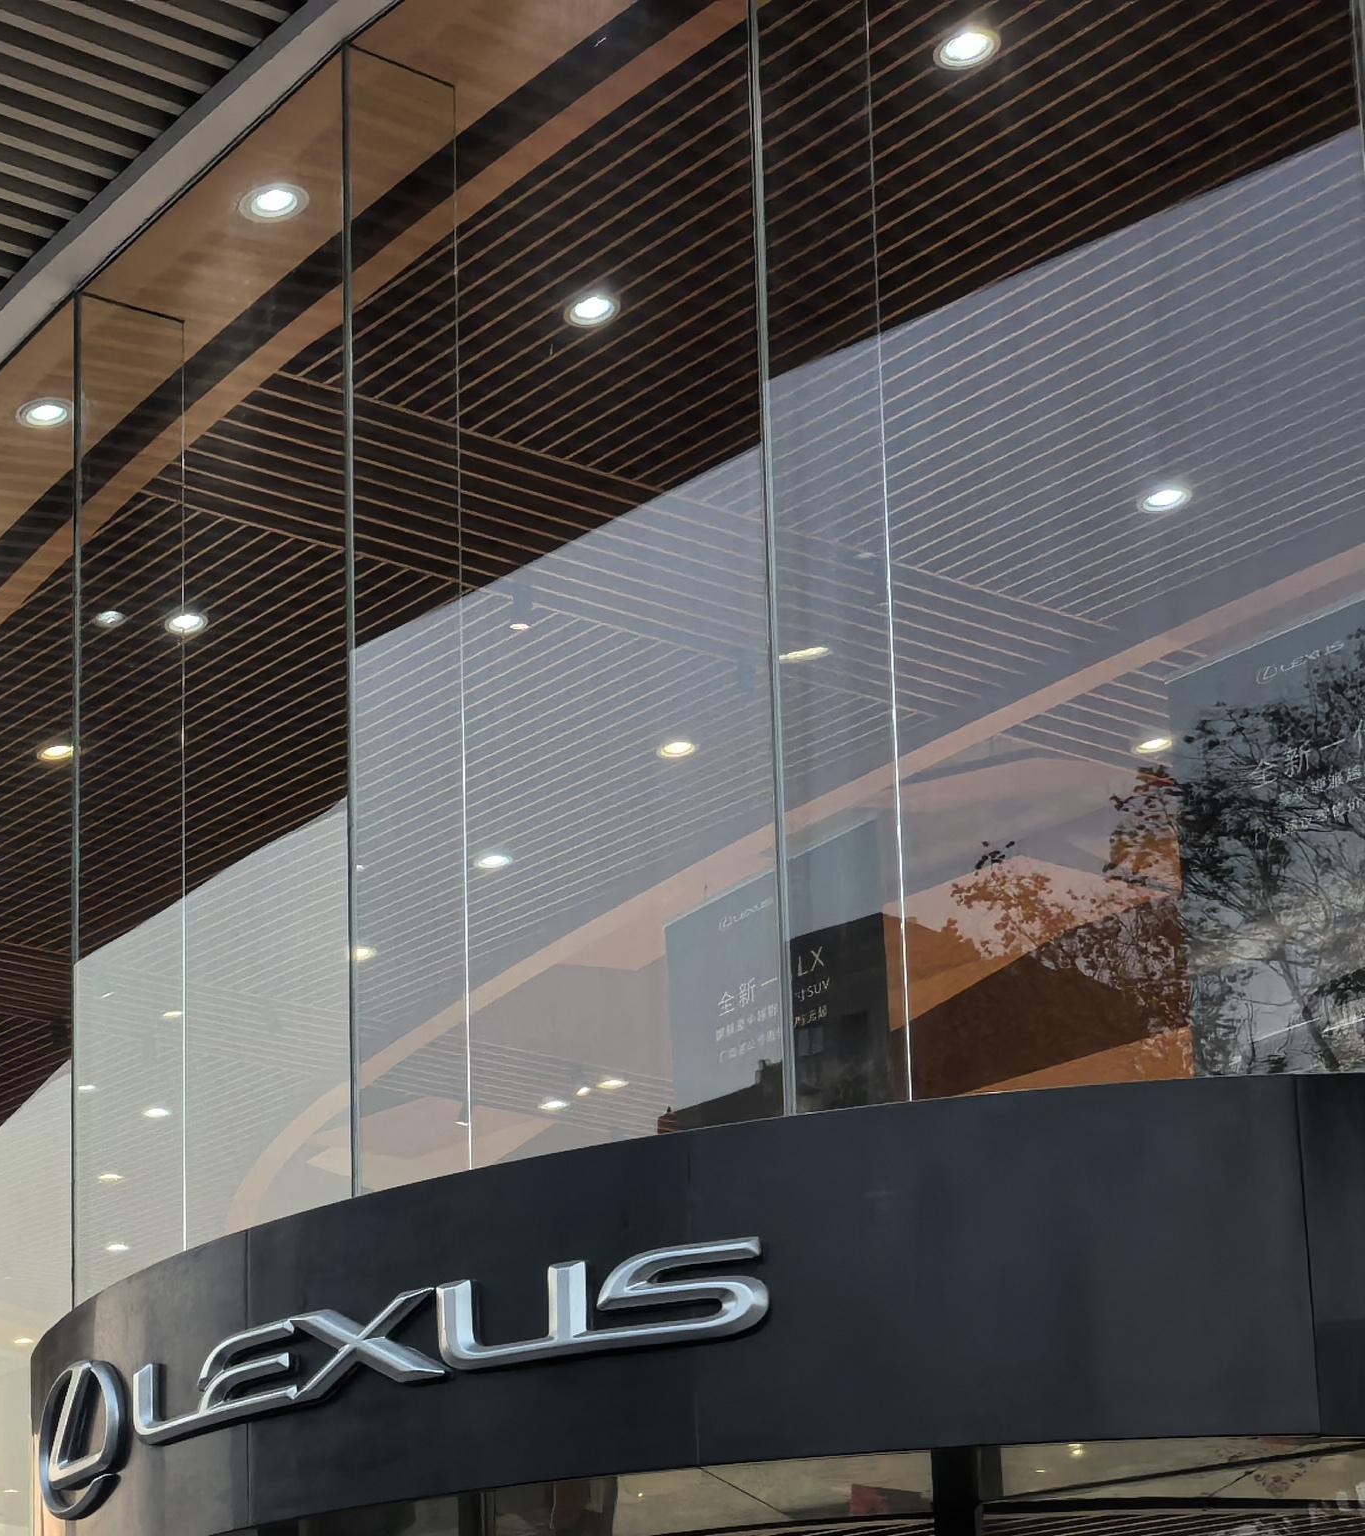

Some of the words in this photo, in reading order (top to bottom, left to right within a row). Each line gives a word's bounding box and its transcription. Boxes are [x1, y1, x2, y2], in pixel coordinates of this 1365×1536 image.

[717, 976, 778, 1017] 全新一
[797, 946, 825, 977] LX
[132, 1235, 770, 1447] LEXUS
